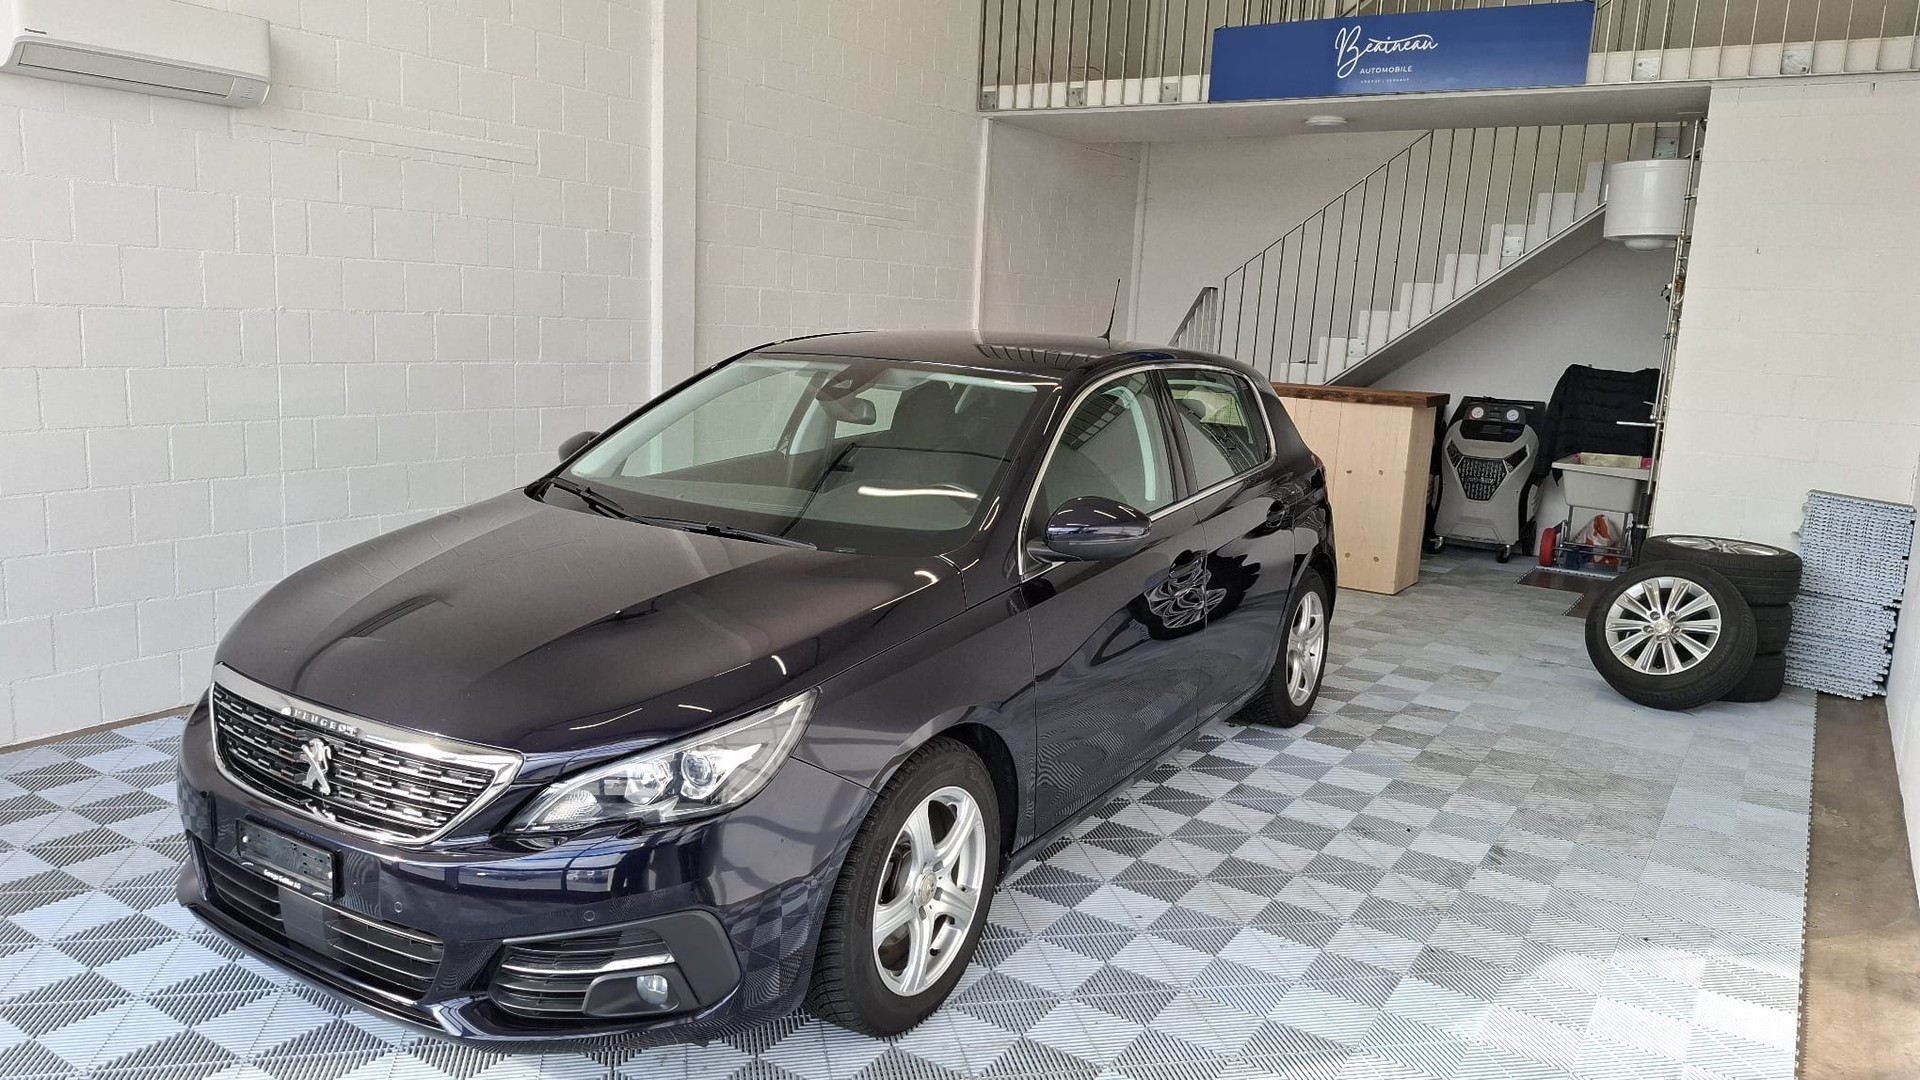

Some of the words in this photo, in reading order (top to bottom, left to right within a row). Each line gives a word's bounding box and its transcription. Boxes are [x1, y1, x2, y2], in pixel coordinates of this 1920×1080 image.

[1335, 25, 1438, 79] Beaineau
[1359, 65, 1413, 75] AUTOMOBILE
[294, 709, 358, 737] PEUGEOT
